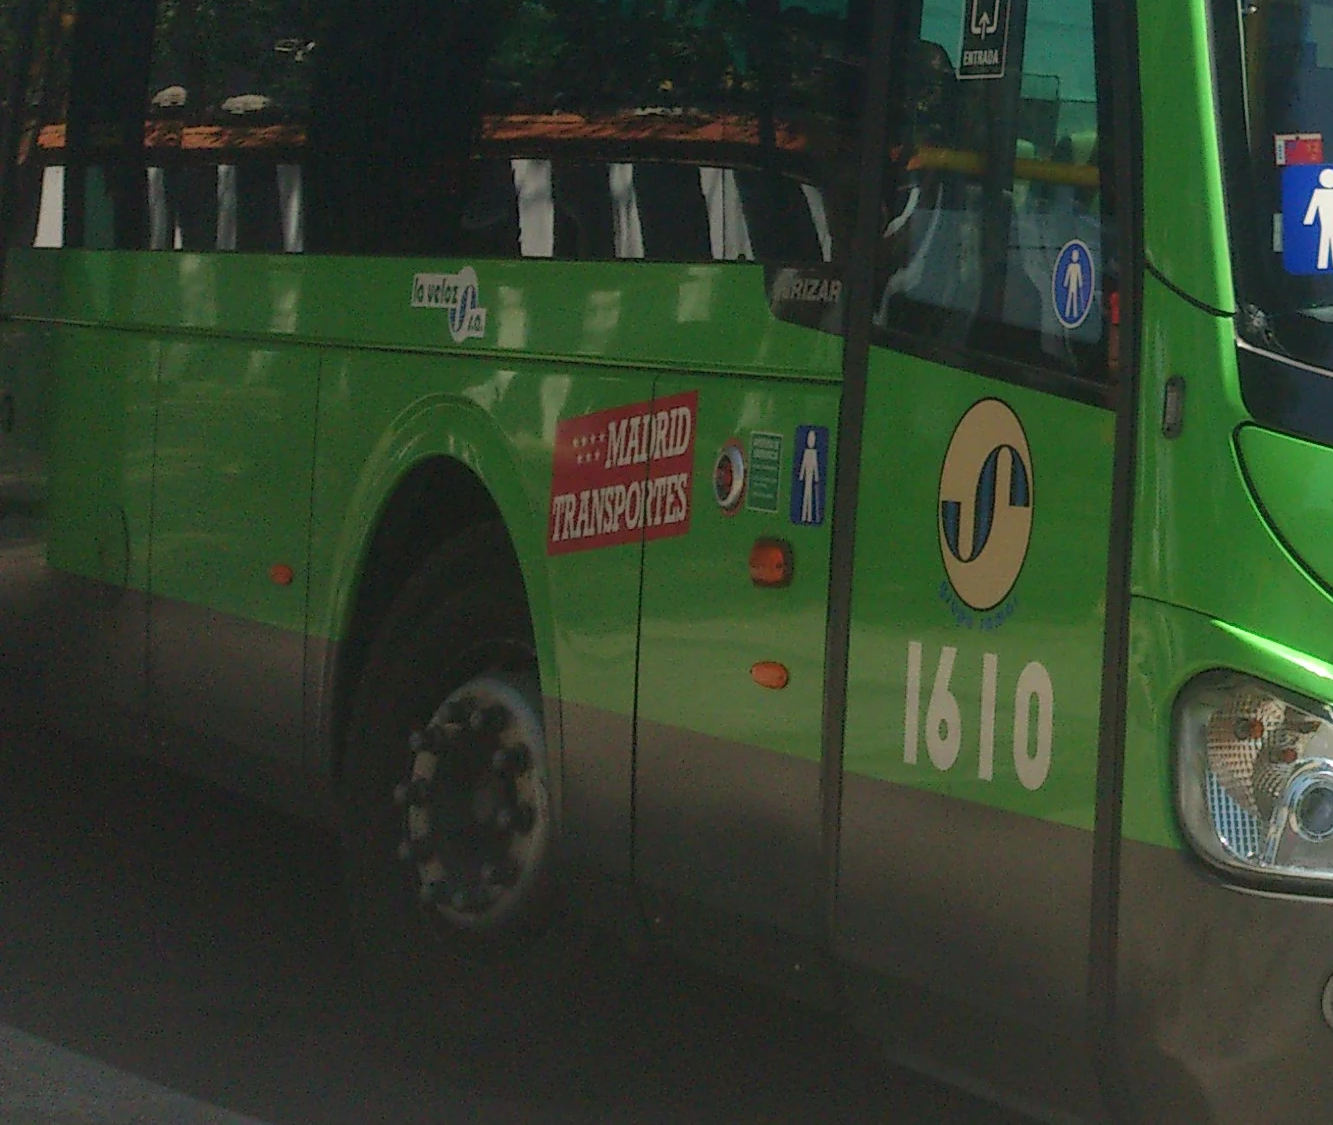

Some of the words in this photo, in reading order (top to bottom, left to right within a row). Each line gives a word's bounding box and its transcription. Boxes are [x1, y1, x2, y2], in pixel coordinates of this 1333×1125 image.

[963, 49, 999, 66] ENTRADA
[427, 277, 459, 304] veloz
[783, 277, 842, 303] RIZAR
[604, 406, 692, 469] MADRID
[552, 472, 688, 542] TRANSPORTES
[903, 640, 1055, 792] 1610
